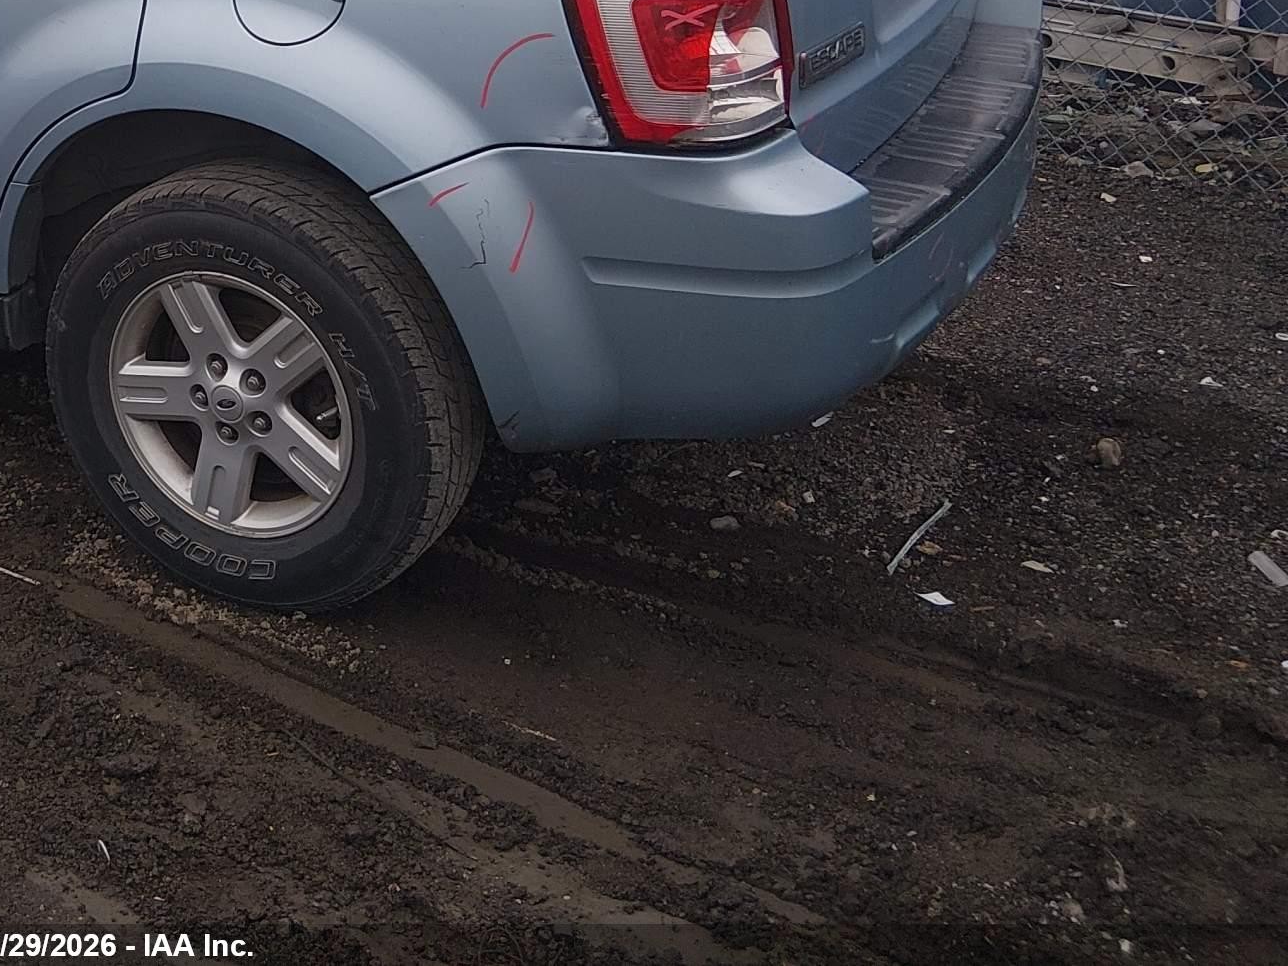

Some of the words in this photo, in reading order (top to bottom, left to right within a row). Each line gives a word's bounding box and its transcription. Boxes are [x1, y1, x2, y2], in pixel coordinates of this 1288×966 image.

[809, 28, 864, 75] ESCAPE
[96, 240, 324, 317] ADVENTURER
[108, 474, 276, 580] COOPER
